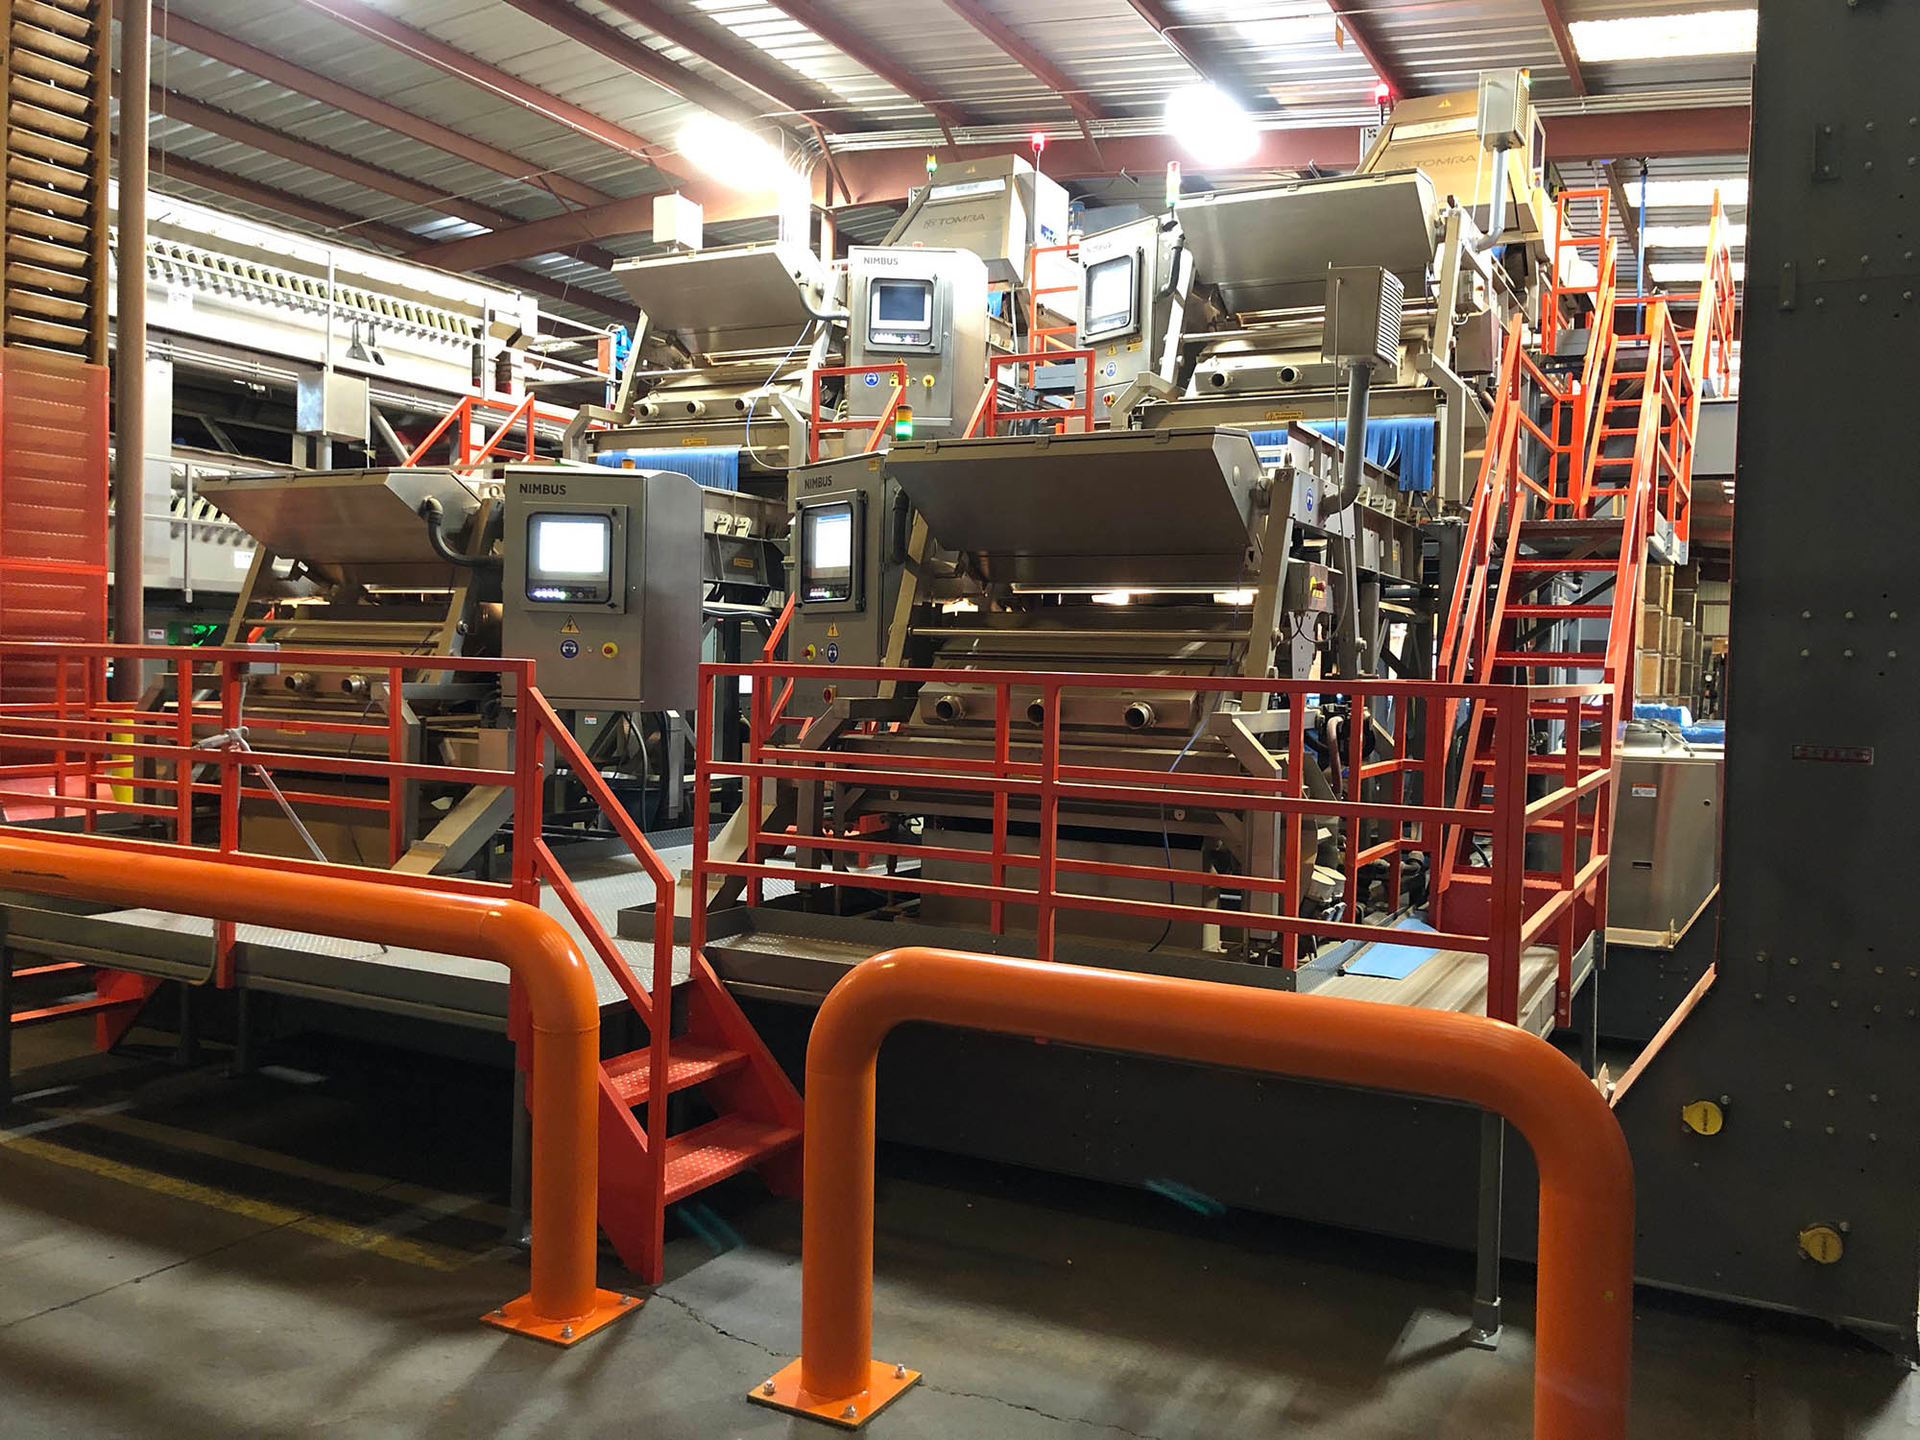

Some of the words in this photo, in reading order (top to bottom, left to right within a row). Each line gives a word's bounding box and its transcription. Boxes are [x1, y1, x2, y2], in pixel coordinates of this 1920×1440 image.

[1414, 154, 1477, 168] TOMRA
[939, 213, 986, 227] TOMRA
[863, 256, 899, 266] NIMBUS
[519, 483, 567, 496] NIMBUS
[804, 475, 833, 490] NIMBUS
